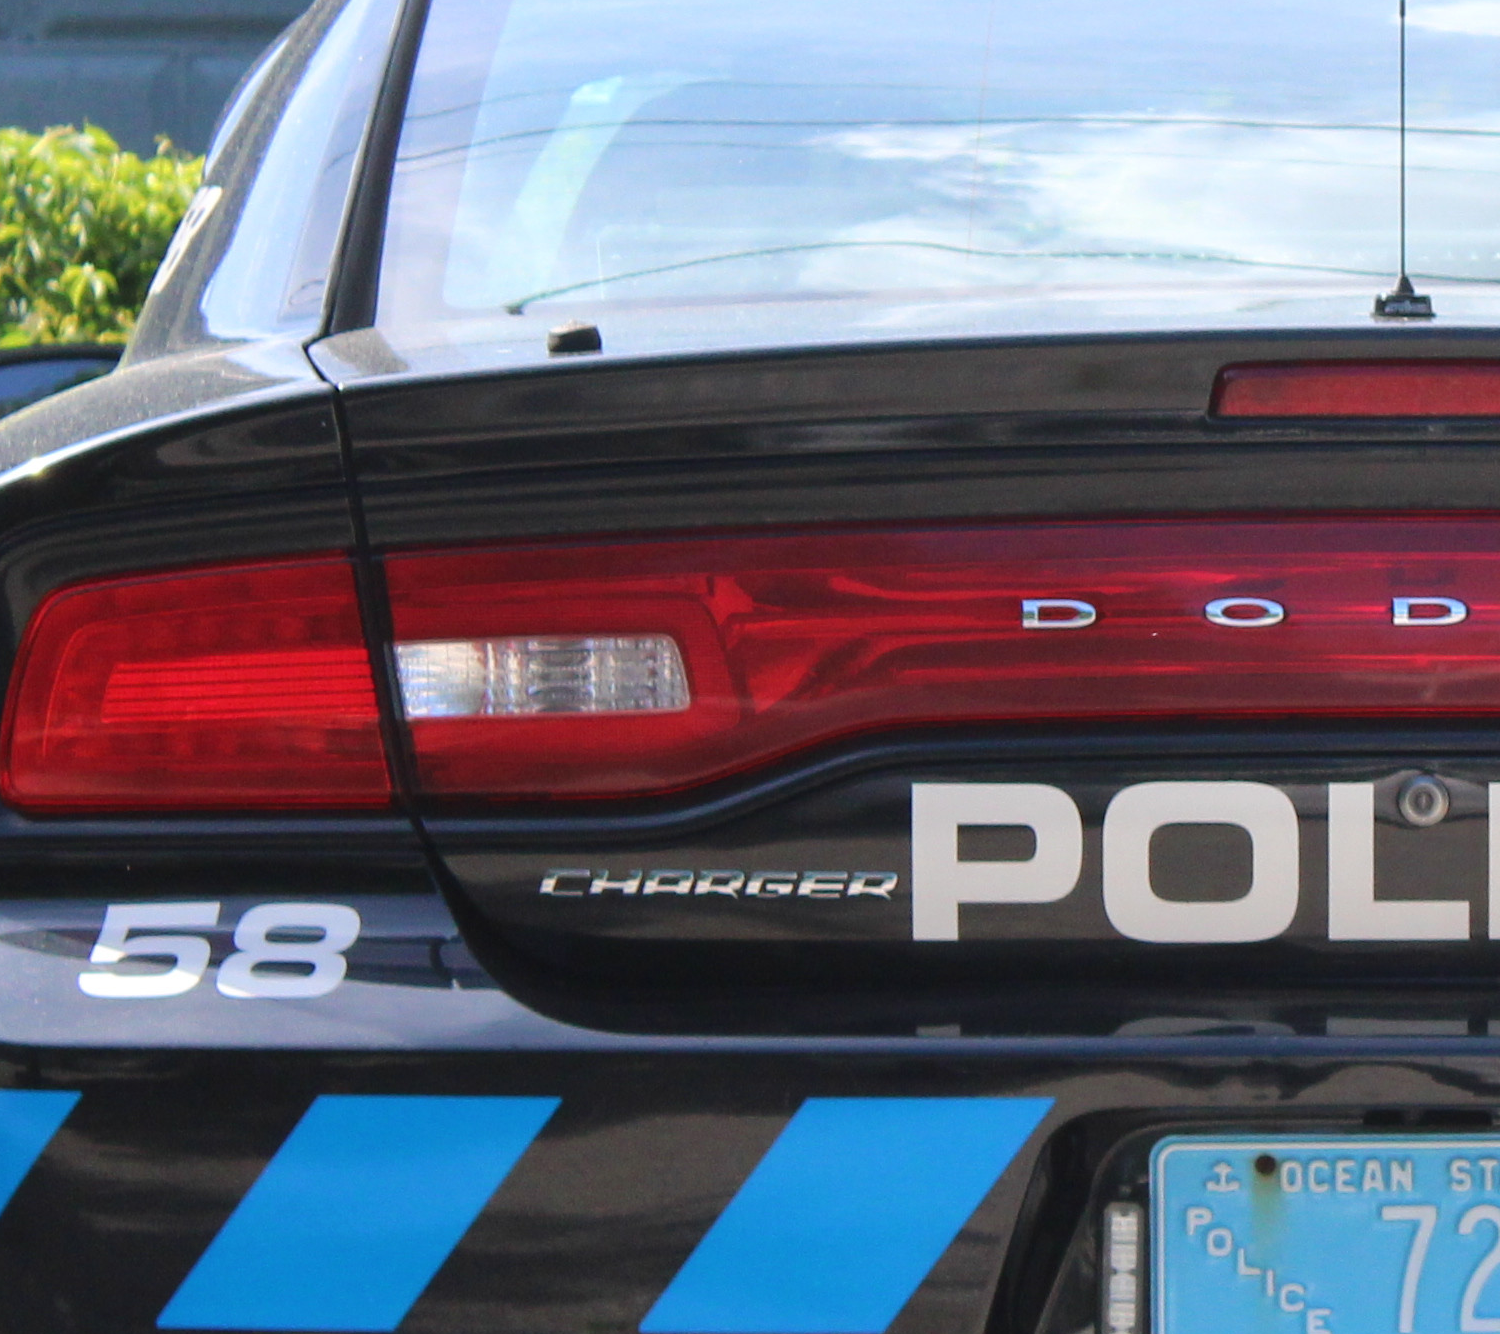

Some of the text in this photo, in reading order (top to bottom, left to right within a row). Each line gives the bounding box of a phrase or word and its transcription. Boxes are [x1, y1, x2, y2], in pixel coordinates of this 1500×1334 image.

[539, 868, 899, 900] CHARGER
[77, 900, 361, 1000] 58
[1279, 1158, 1414, 1194] OCEAN
